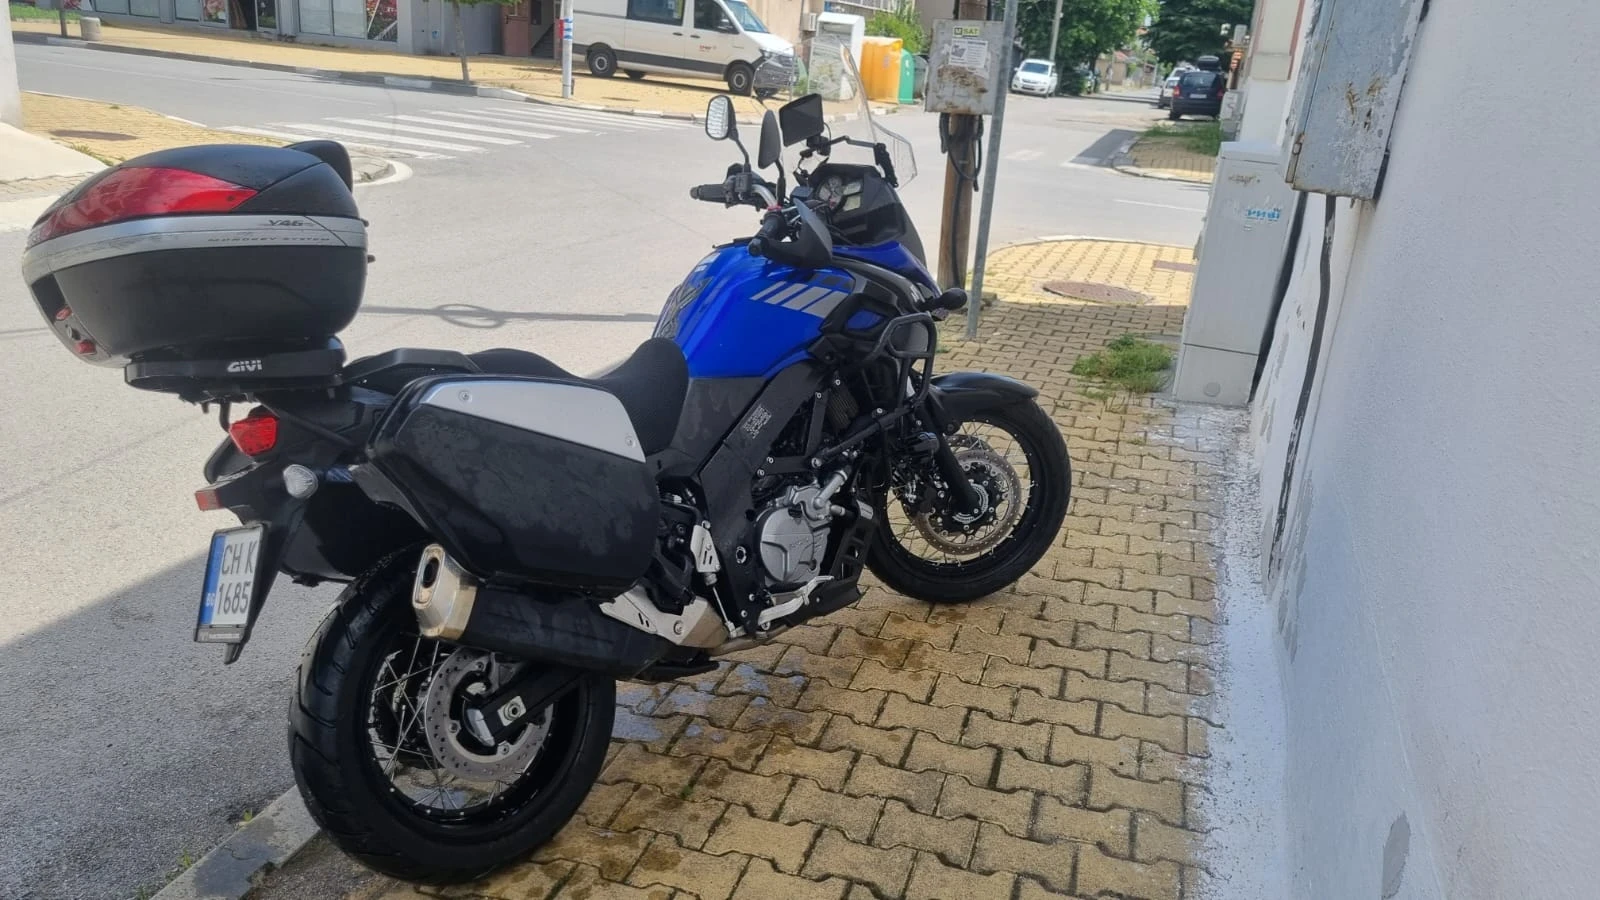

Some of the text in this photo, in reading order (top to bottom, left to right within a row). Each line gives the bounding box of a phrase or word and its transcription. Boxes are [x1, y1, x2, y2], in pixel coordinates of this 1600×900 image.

[227, 359, 263, 373] GIVI
[221, 540, 258, 575] CH K
[217, 581, 252, 615] 1685
